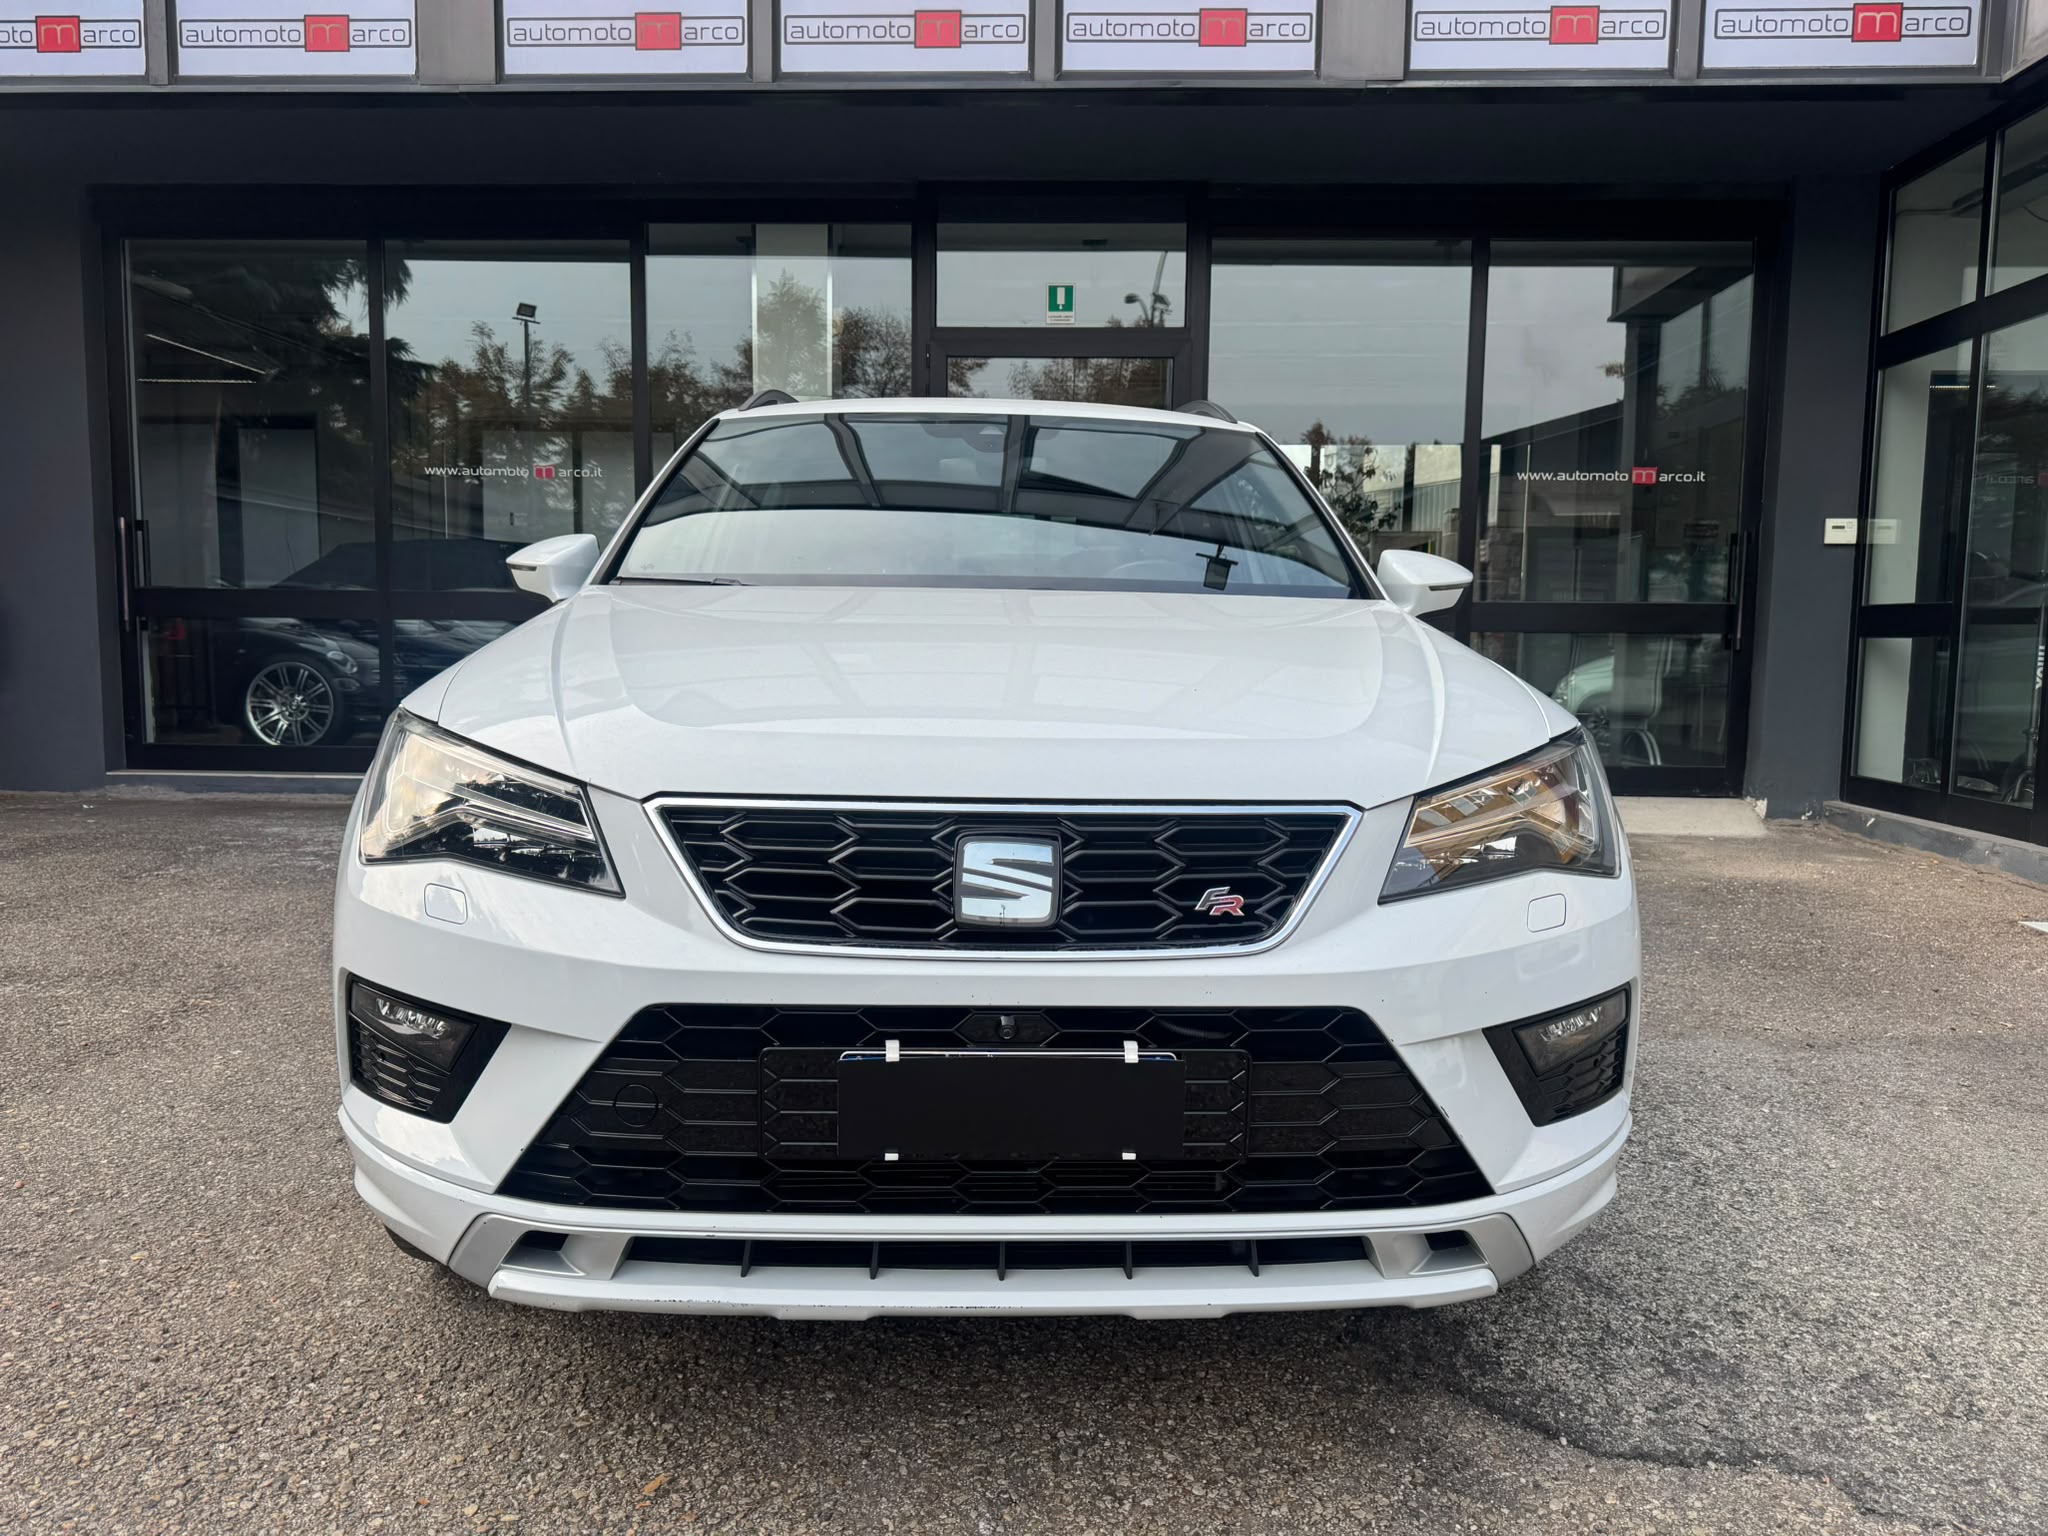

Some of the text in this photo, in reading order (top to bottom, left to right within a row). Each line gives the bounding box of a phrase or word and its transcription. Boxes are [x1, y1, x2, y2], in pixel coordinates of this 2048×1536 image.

[513, 23, 632, 42] automoto
[790, 20, 911, 39] automoto
[1072, 18, 1196, 37] automoto
[1421, 17, 1546, 35] automoto
[1721, 14, 1849, 33] automoto
[185, 25, 301, 43] automoto
[1195, 886, 1245, 916] FR
